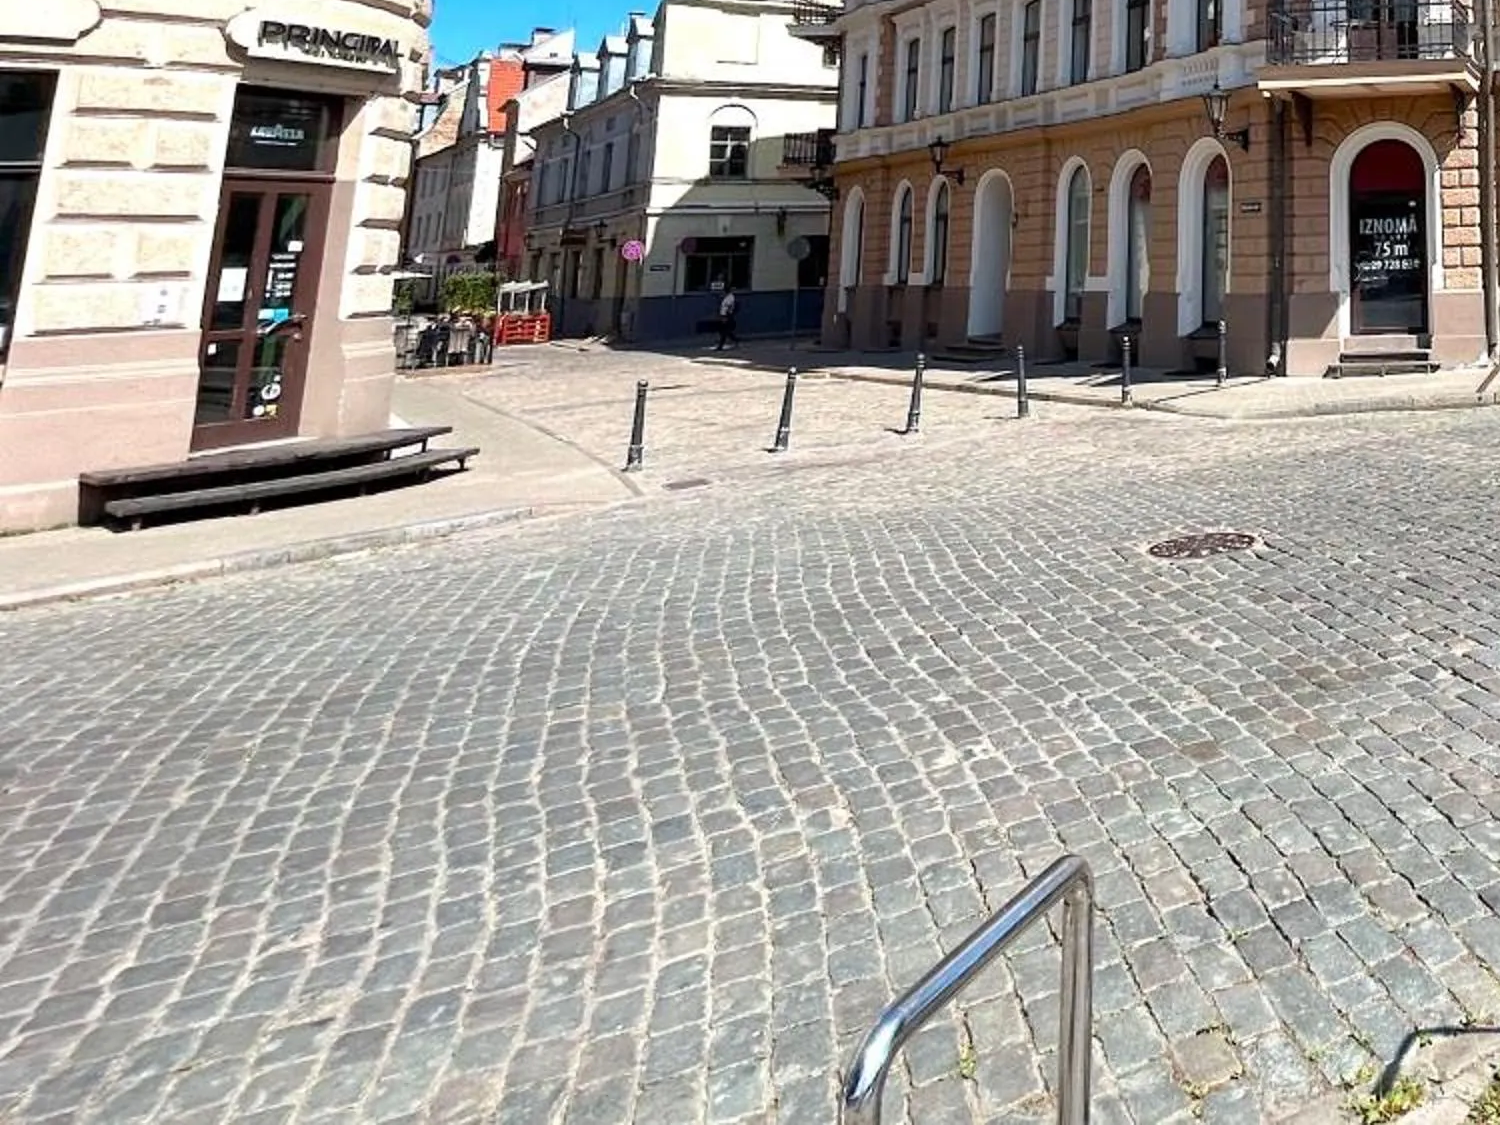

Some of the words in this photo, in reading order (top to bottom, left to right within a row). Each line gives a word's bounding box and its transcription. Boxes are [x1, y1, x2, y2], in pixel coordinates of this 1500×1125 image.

[259, 21, 404, 59] PRINCIPAL
[1359, 213, 1417, 235] IZNOMĀ
[1374, 241, 1391, 257] 75
